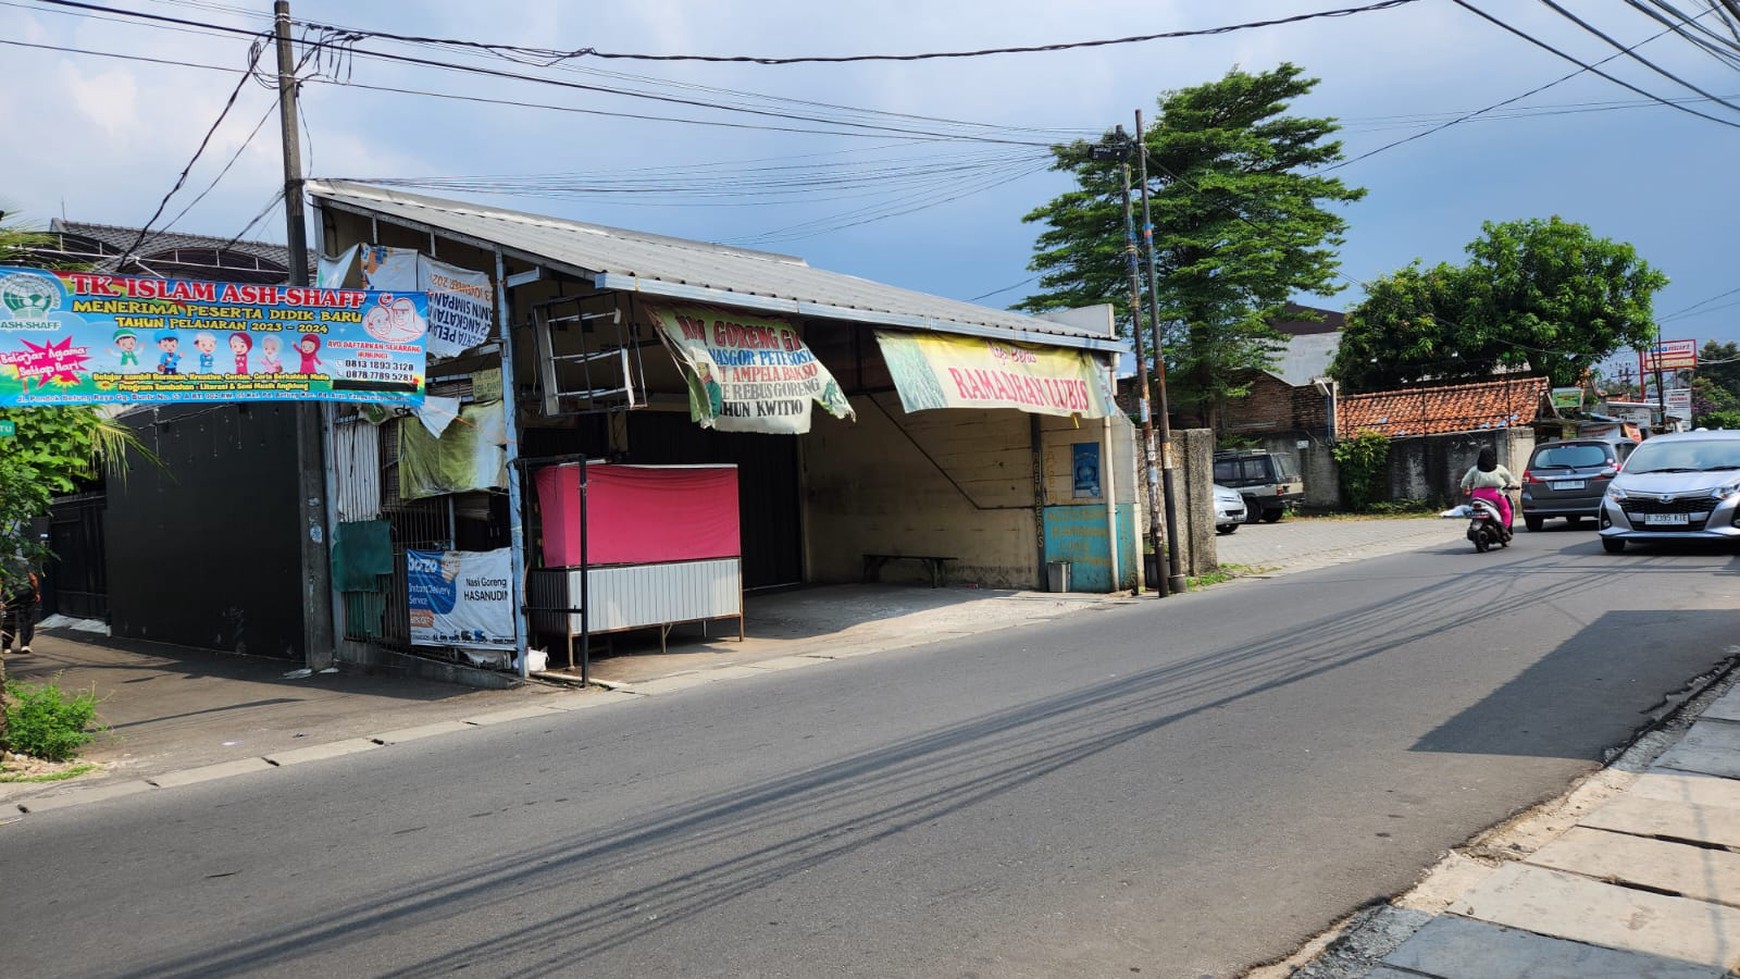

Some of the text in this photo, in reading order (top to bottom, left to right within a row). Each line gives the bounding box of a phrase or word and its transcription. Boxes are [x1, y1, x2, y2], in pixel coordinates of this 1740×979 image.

[71, 275, 121, 296] TK.
[126, 278, 216, 302] ISLAM
[221, 283, 367, 308] ASH-SHAFF
[73, 300, 363, 323] MENERIMA PESERTA DIDIK BARU
[1, 321, 60, 329] ASH-SHAFF
[114, 317, 164, 328] TAHUN
[169, 319, 247, 330] PELAJARAN
[251, 322, 282, 331] 2023
[298, 324, 328, 333] 2024
[712, 320, 780, 350] GORENG
[343, 342, 384, 350] DAFTARKAN
[385, 344, 421, 352] SEKARANG
[357, 351, 388, 359] HUBUNGI
[0, 347, 86, 365] Belajar Agama
[707, 348, 756, 366] NASGOR
[19, 360, 79, 377] Setiap Hari
[345, 360, 367, 368] 0813
[370, 361, 391, 370] 1893
[732, 366, 781, 382] AMPELA
[782, 363, 818, 381] BAKSO
[392, 373, 413, 381] 5281
[118, 384, 154, 392] Program
[732, 383, 773, 400] REBUS
[774, 378, 820, 397] GORENG
[948, 367, 1090, 412] RAMADHAN LUBIS
[466, 577, 507, 589] Nasi Goreng
